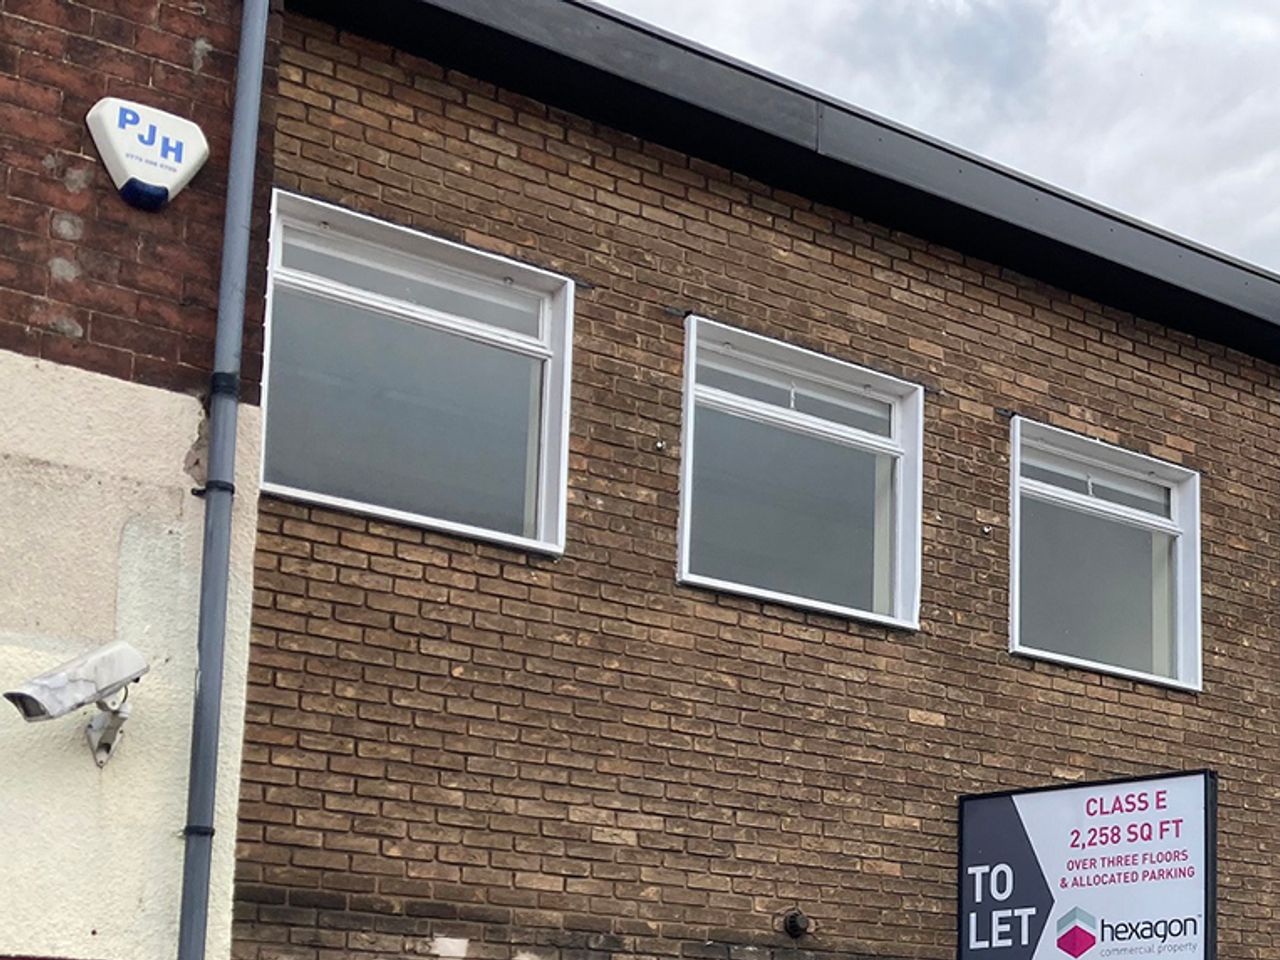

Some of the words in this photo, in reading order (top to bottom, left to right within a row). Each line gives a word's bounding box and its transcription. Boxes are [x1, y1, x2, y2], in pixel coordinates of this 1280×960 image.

[117, 106, 184, 163] PJH
[1086, 792, 1149, 816] CLASS
[1155, 790, 1167, 809] E
[1070, 825, 1121, 850] 2,258
[1126, 822, 1153, 842] SQ
[1159, 818, 1183, 840] FT
[1066, 858, 1097, 871] OVER
[1101, 854, 1139, 868] THREE
[1141, 849, 1189, 865] FLOORS
[967, 863, 1014, 903] TO
[1059, 877, 1068, 889] &
[1071, 871, 1139, 888] ALLOCATED
[1141, 866, 1195, 881] PARKING
[968, 907, 1037, 949] LET
[1100, 915, 1198, 944] hexagon
[1100, 944, 1155, 957] commercial
[1157, 941, 1198, 955] property
